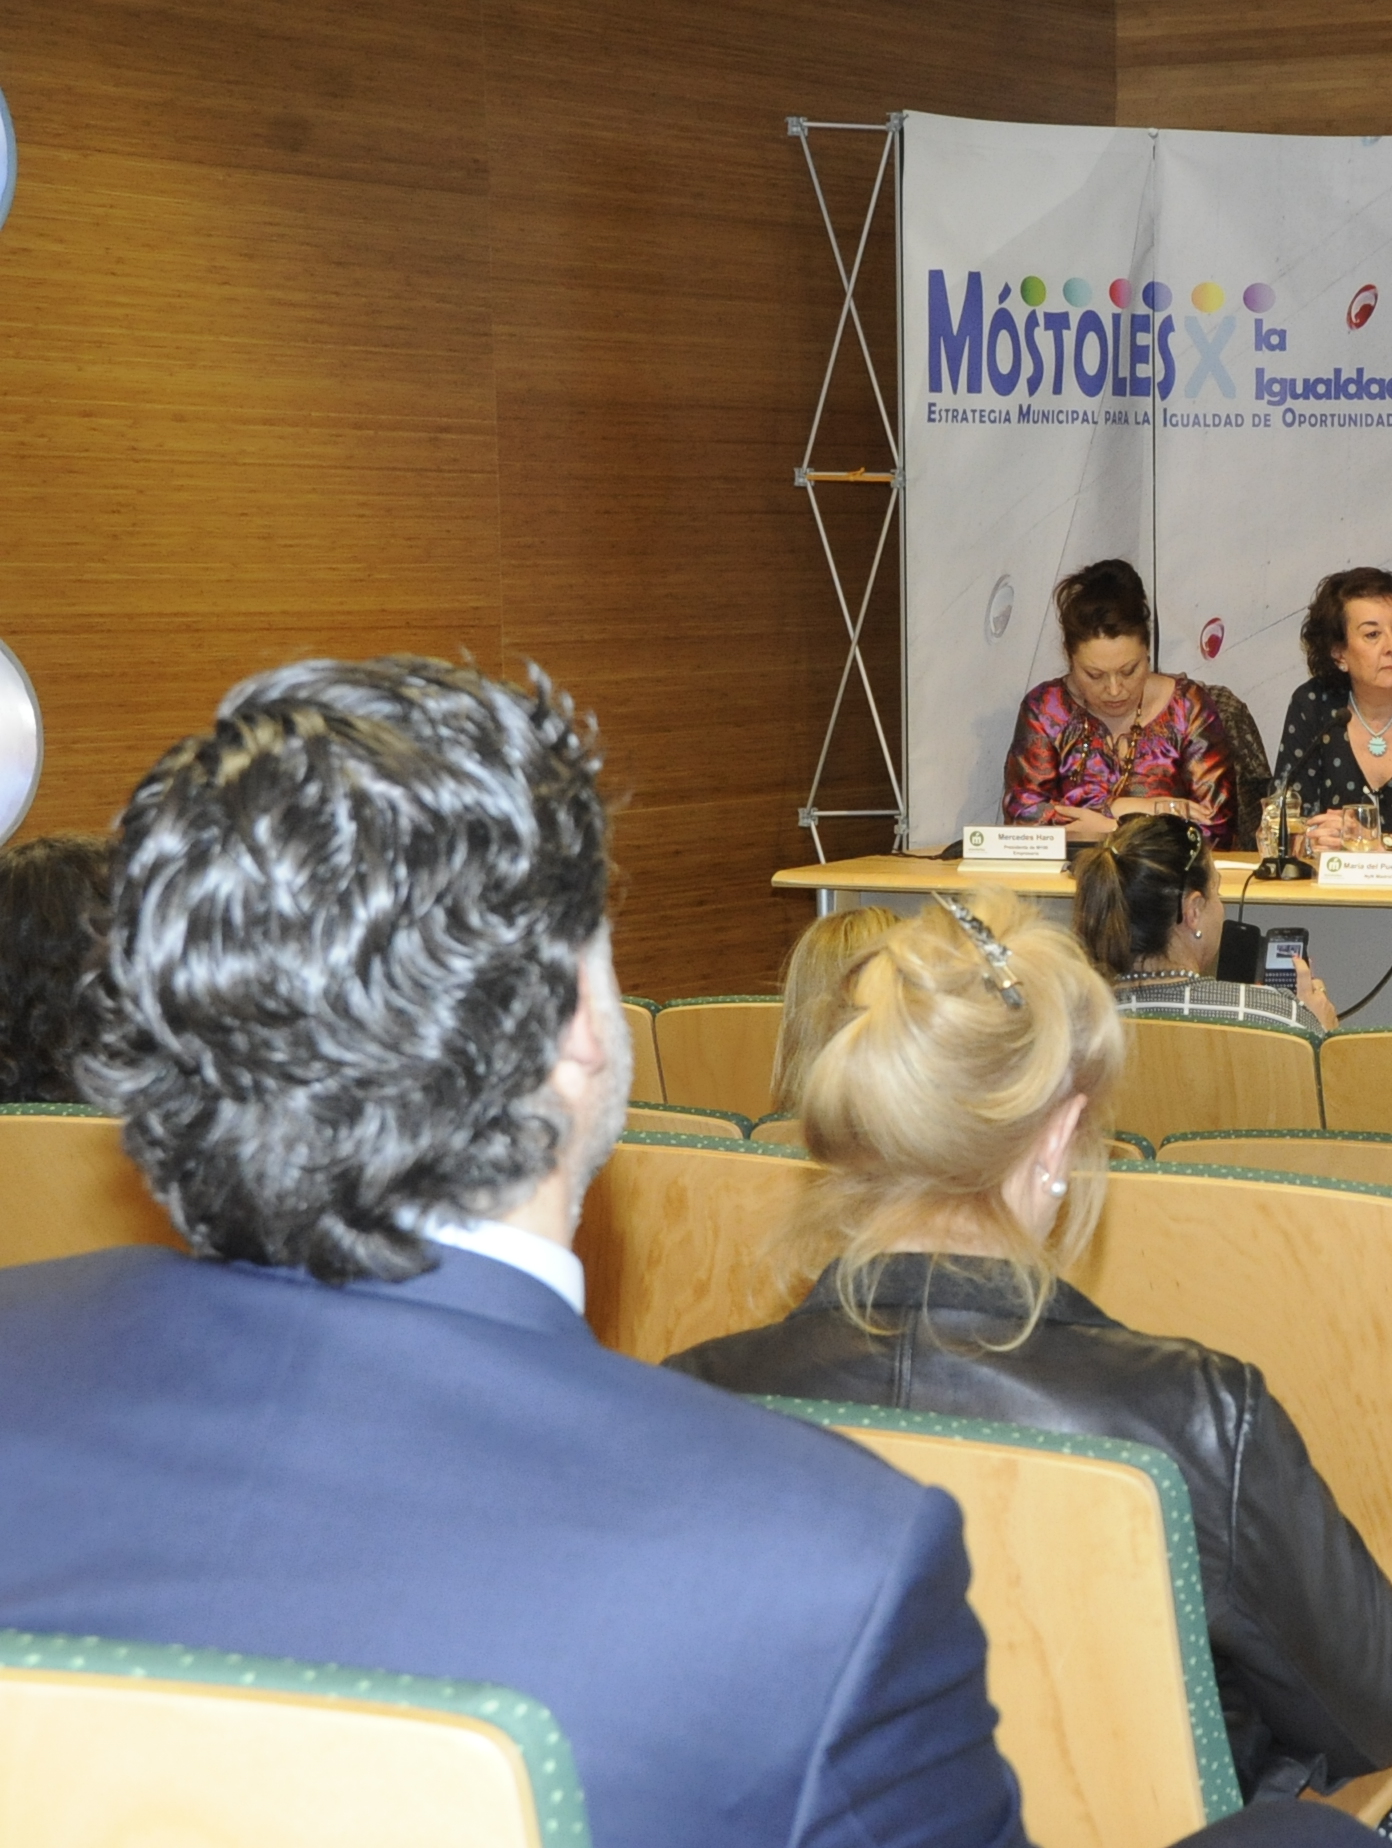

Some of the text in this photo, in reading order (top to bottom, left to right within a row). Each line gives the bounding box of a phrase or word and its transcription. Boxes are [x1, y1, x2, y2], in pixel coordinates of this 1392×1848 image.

[928, 269, 1175, 401] MÓSTOLES
[1254, 318, 1287, 352] la
[927, 402, 1012, 425] ESTRATEGIA
[1016, 403, 1099, 425] MUNICIPAL
[1104, 409, 1130, 426] PARA
[1134, 409, 1151, 426] LA
[1162, 408, 1245, 428] IGUALDAD
[1251, 412, 1272, 428] DE
[998, 833, 1054, 841] Mercedes Haro
